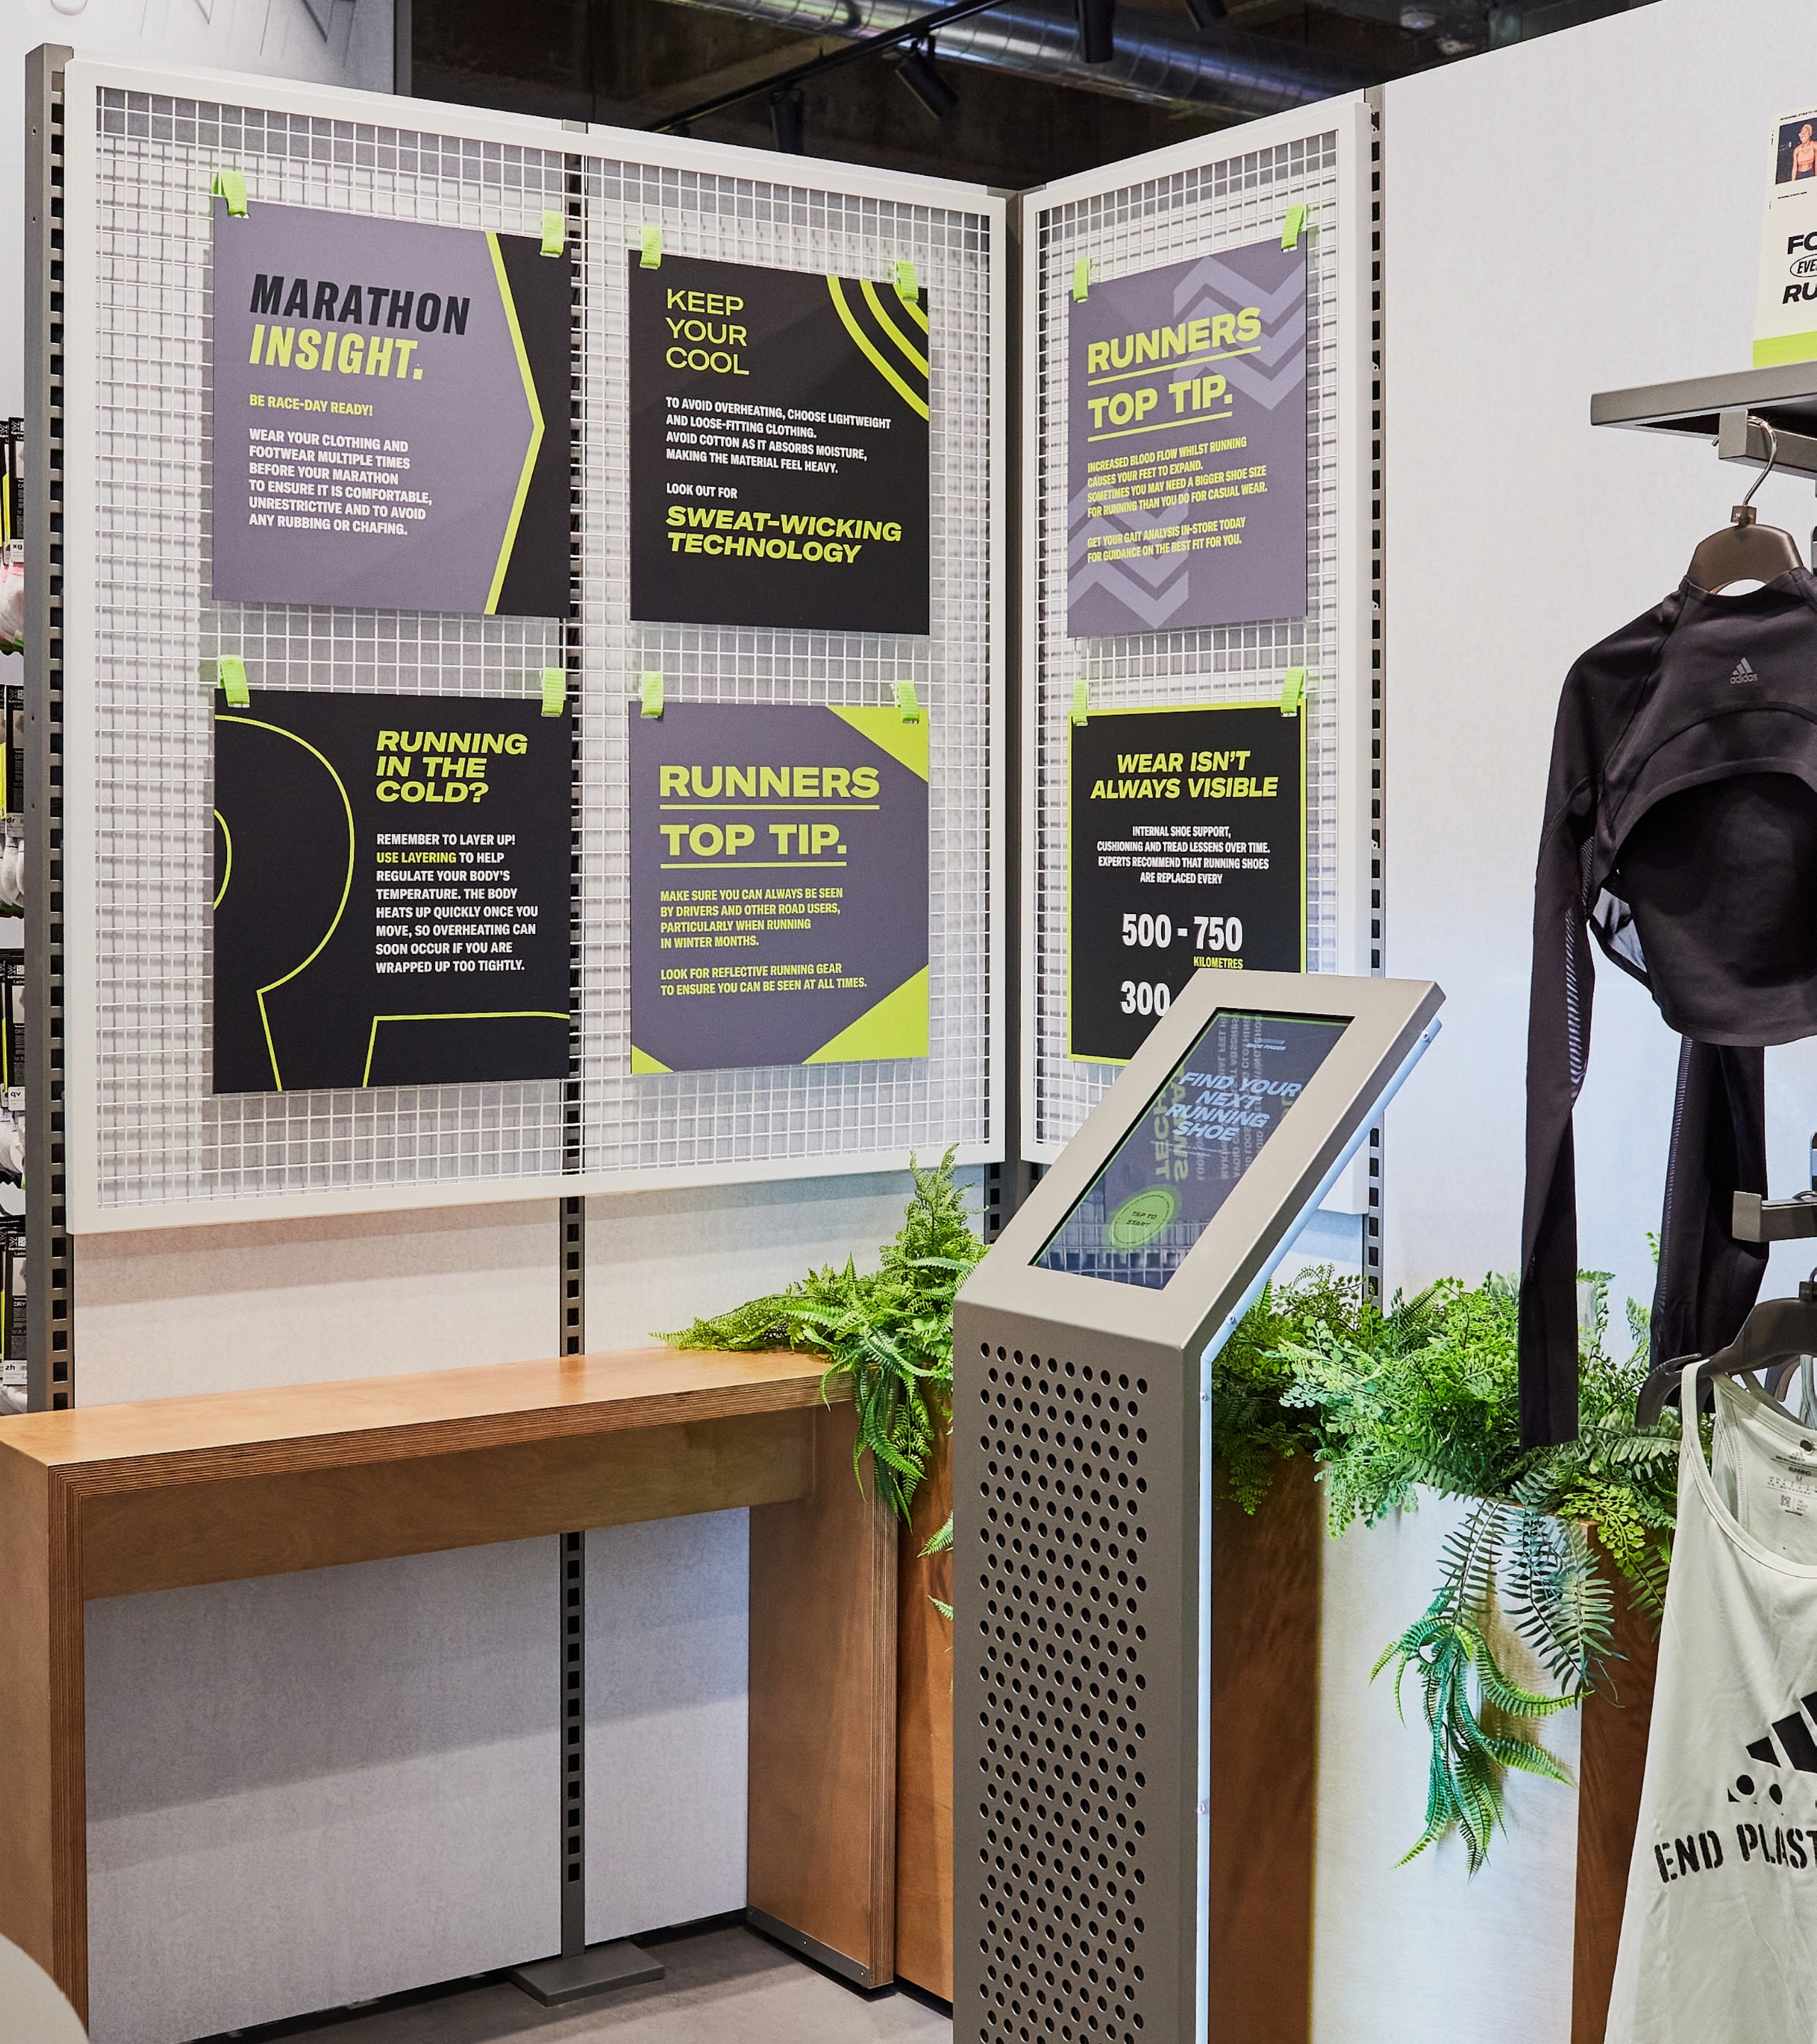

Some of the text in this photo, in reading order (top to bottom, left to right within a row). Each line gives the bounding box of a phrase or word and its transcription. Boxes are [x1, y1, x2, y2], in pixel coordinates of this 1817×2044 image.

[250, 273, 471, 336] MARATHON
[667, 289, 744, 316] KEEP
[1782, 282, 1817, 304] RU
[666, 317, 747, 346] YOUR
[1087, 307, 1262, 374] RUNNERS
[248, 324, 423, 380] INSIGHT.
[666, 347, 750, 375] COOL
[249, 394, 373, 417] BE RACE-DAY READY!
[665, 396, 891, 429] TO AVOID OVERHEATING, CHOOSE LIGHTWEIGHT
[1087, 374, 1234, 429] TOP TIP.
[666, 414, 817, 439] AND LOOSE-FITTING CLOTHING.
[249, 428, 409, 452] WEAR YOUR CLOTHING AND
[249, 445, 410, 469] FOOTWEAR MULTIPLE TIMES
[666, 448, 838, 473] MAKING THE MATERIAL FEEL HEAVY.
[1087, 436, 1247, 473] INCREASED BLOOD FLOW WHILST RUNNING
[249, 462, 399, 485] BEFORE YOUR MARATHON
[248, 479, 432, 505] TO ENSURE IT IS COMFORTABLE,
[666, 483, 738, 499] LOOK OUT FOR
[249, 497, 426, 520] UNRESTRICTIVE AND TO AVOID
[248, 513, 408, 535] ANY RUBBING OR CHAFING.
[667, 506, 901, 541] SWEAT-WICKING
[1087, 517, 1246, 548] GET YOUR GAIT ANALYSIS IN-STORE TODAY
[669, 532, 860, 563] TECHNOLOGY
[1730, 673, 1758, 684] adidas
[377, 730, 527, 754] RUNNING
[376, 756, 487, 778] IN THE
[1117, 752, 1184, 773] WEAR
[376, 781, 488, 803] COLD?
[660, 766, 879, 798] RUNNERS
[1091, 776, 1278, 799] ALWAYS VISIBLE
[377, 833, 515, 845] REMEMBER TO LAYER UP!
[660, 823, 847, 856] TOP TIP.
[1132, 825, 1231, 838] INTERNAL SHOE SUPPORT,
[376, 852, 505, 864] USE LAYERING TO HELP
[1097, 840, 1270, 853] CUSHIONING AND TREAD LESSENS OVER TIME.
[376, 870, 434, 881] REGULATE
[437, 870, 467, 881] YOUR
[1140, 872, 1223, 884] ARE REPLACED EVERY
[375, 888, 517, 900] TEMPERATURE. THE BODY
[660, 887, 843, 901] MAKE SURE YOU CAN ALWAYS BE SEEN
[376, 923, 536, 938] MOVE, SO OVERHEATING CAN
[660, 918, 811, 933] PARTICULARLY WHEN RUNNING
[1122, 913, 1172, 947] 500
[1194, 916, 1243, 952] 750
[660, 935, 759, 949] IN WINTER MONTHS.
[375, 959, 525, 974] WRAPPED UP TOO TIGHTLY.
[661, 962, 842, 980] LOOK FOR REFLECTIVE RUNNING GEAR
[1193, 955, 1244, 969] KILOMETRES
[1120, 980, 1171, 1017] 300
[1178, 1072, 1302, 1097] FIND YOUR
[1195, 1090, 1263, 1109] NEXT
[1164, 1103, 1270, 1128] RUNNING
[1172, 1121, 1240, 1141] SHOE
[1654, 1830, 1725, 1883] END
